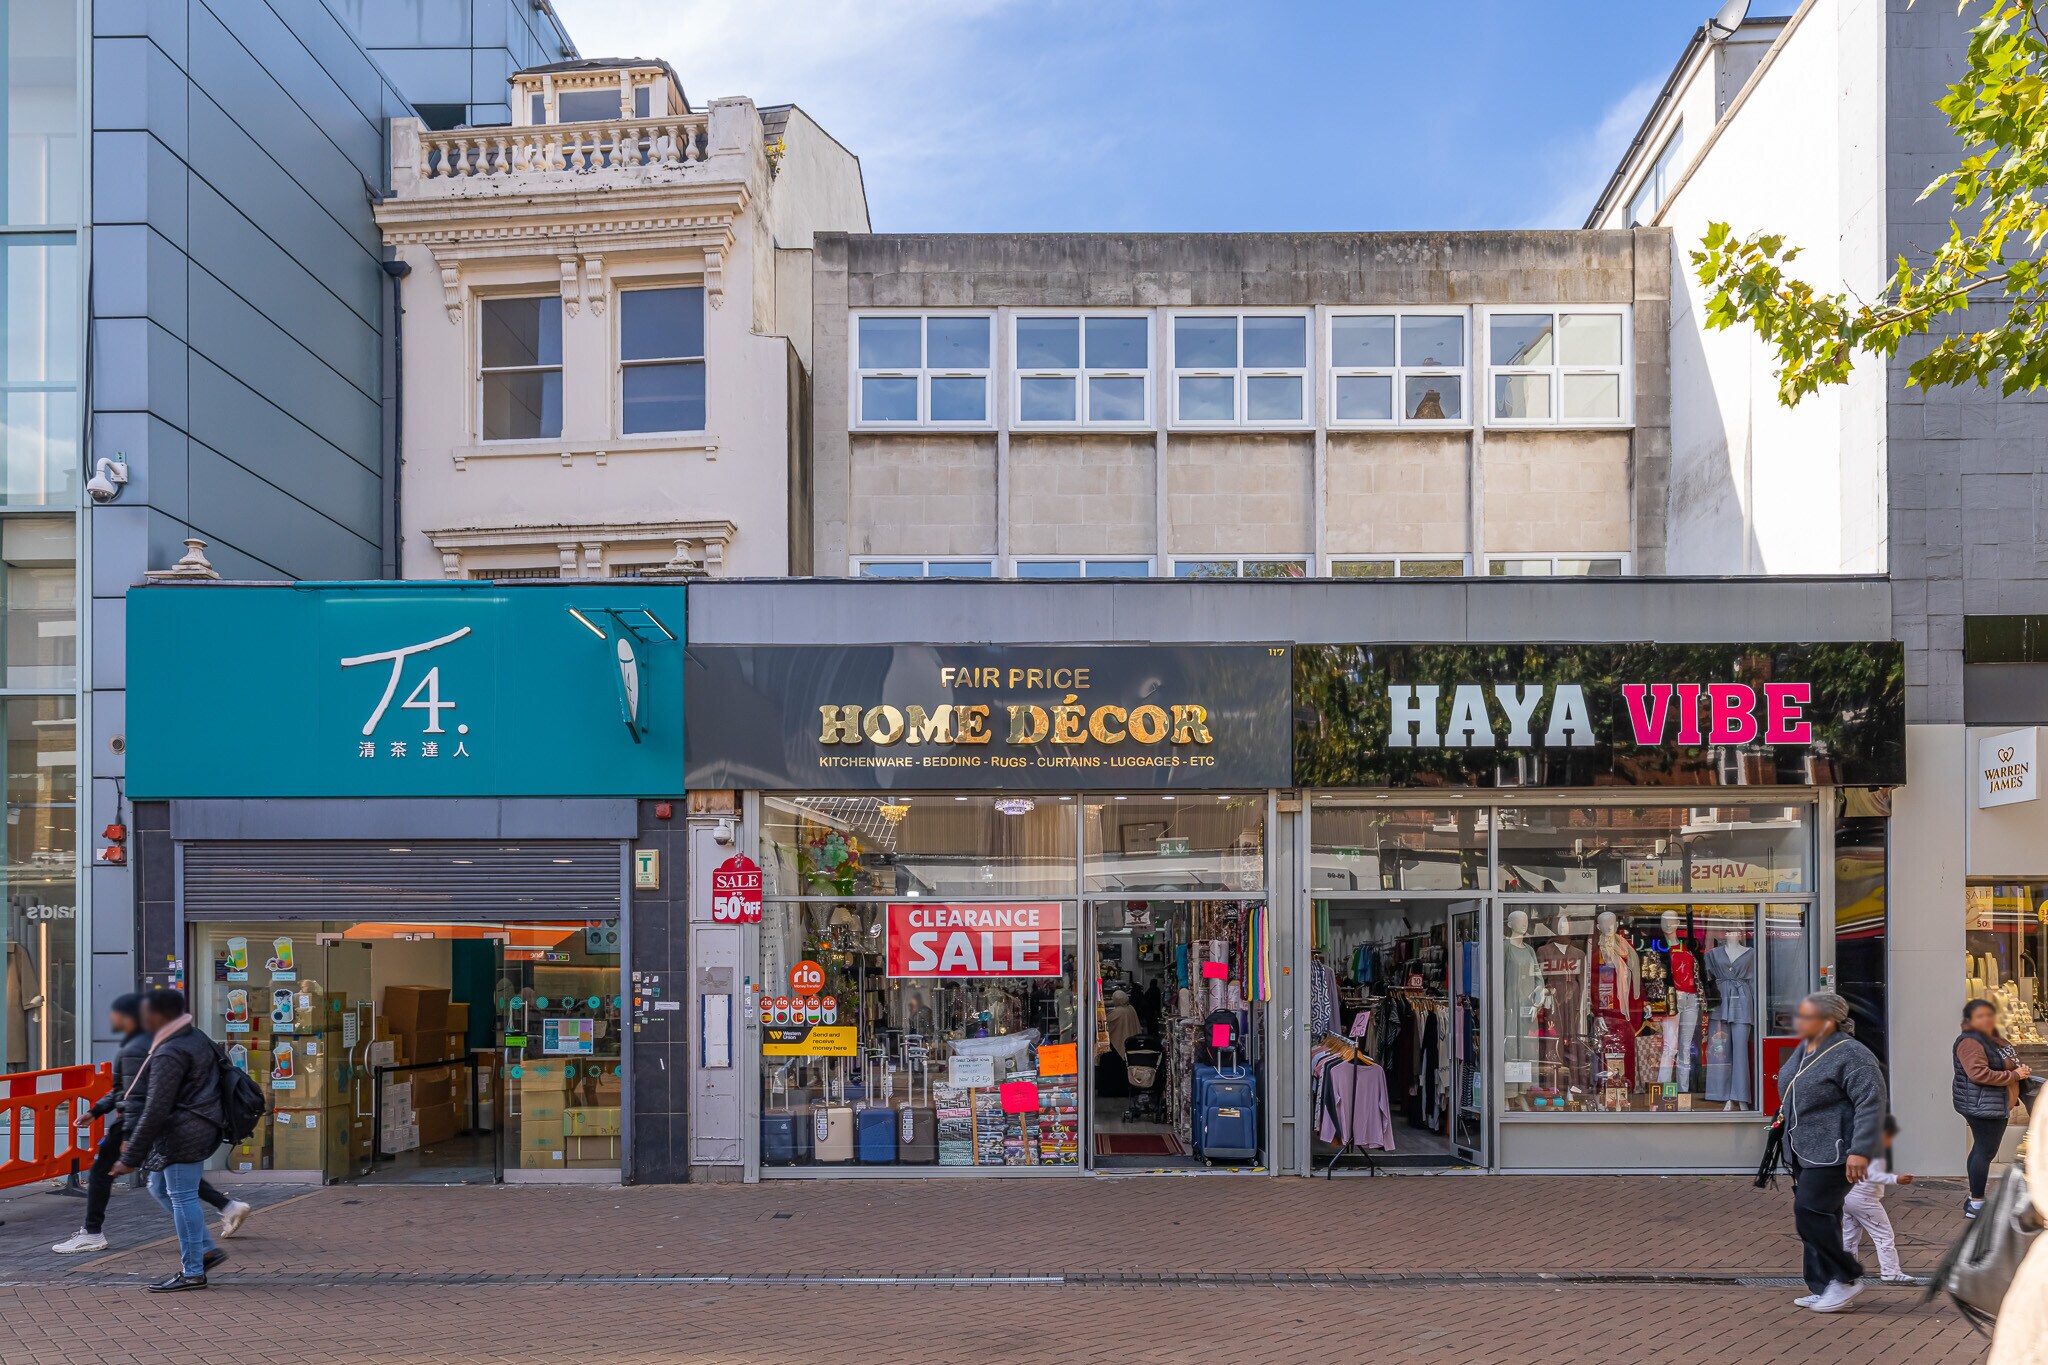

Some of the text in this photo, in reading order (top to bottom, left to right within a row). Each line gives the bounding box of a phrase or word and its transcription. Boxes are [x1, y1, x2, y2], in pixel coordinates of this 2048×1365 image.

[1268, 648, 1285, 657] 117
[940, 667, 1090, 690] FAIR PRICE
[818, 694, 1214, 745] HOME DÉCOR
[1387, 682, 1812, 747] HAYA VIBE
[358, 740, 471, 759] 清茶達人
[819, 756, 913, 768] KITCHENWARE
[923, 756, 981, 768] BEDDING
[991, 756, 1027, 768] RUGS
[1037, 756, 1101, 768] CURTAINS
[1110, 756, 1179, 768] LUGGAGES
[1190, 756, 1215, 768] ETC
[1984, 762, 2029, 781] WARREN
[1989, 776, 2023, 794] JAMES
[639, 857, 652, 872] T
[716, 874, 759, 889] SALE
[744, 901, 761, 915] OFF
[908, 910, 1040, 928] CLEARANCE
[908, 931, 1040, 972] SALE
[793, 965, 821, 983] ria
[760, 998, 772, 1006] ria
[776, 998, 788, 1006] ria
[792, 998, 803, 1006] ria
[807, 998, 819, 1006] ria
[823, 998, 835, 1006] ria
